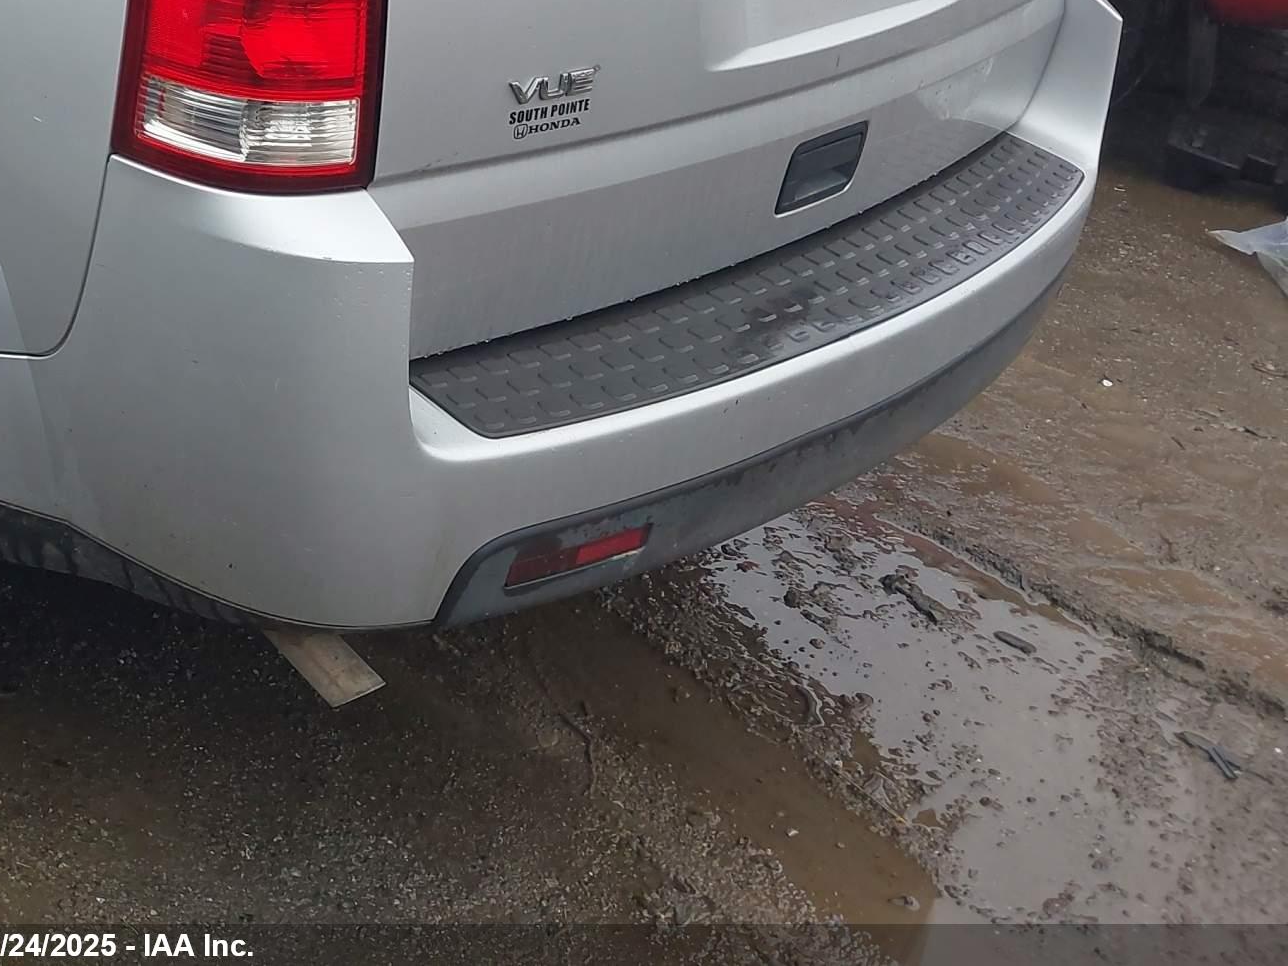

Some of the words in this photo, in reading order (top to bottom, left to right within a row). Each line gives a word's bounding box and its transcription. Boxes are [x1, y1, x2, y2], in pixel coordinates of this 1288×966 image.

[508, 68, 595, 105] VUE
[509, 106, 549, 125] SOUTH
[550, 98, 591, 118] POINTE
[527, 117, 581, 135] HONDA
